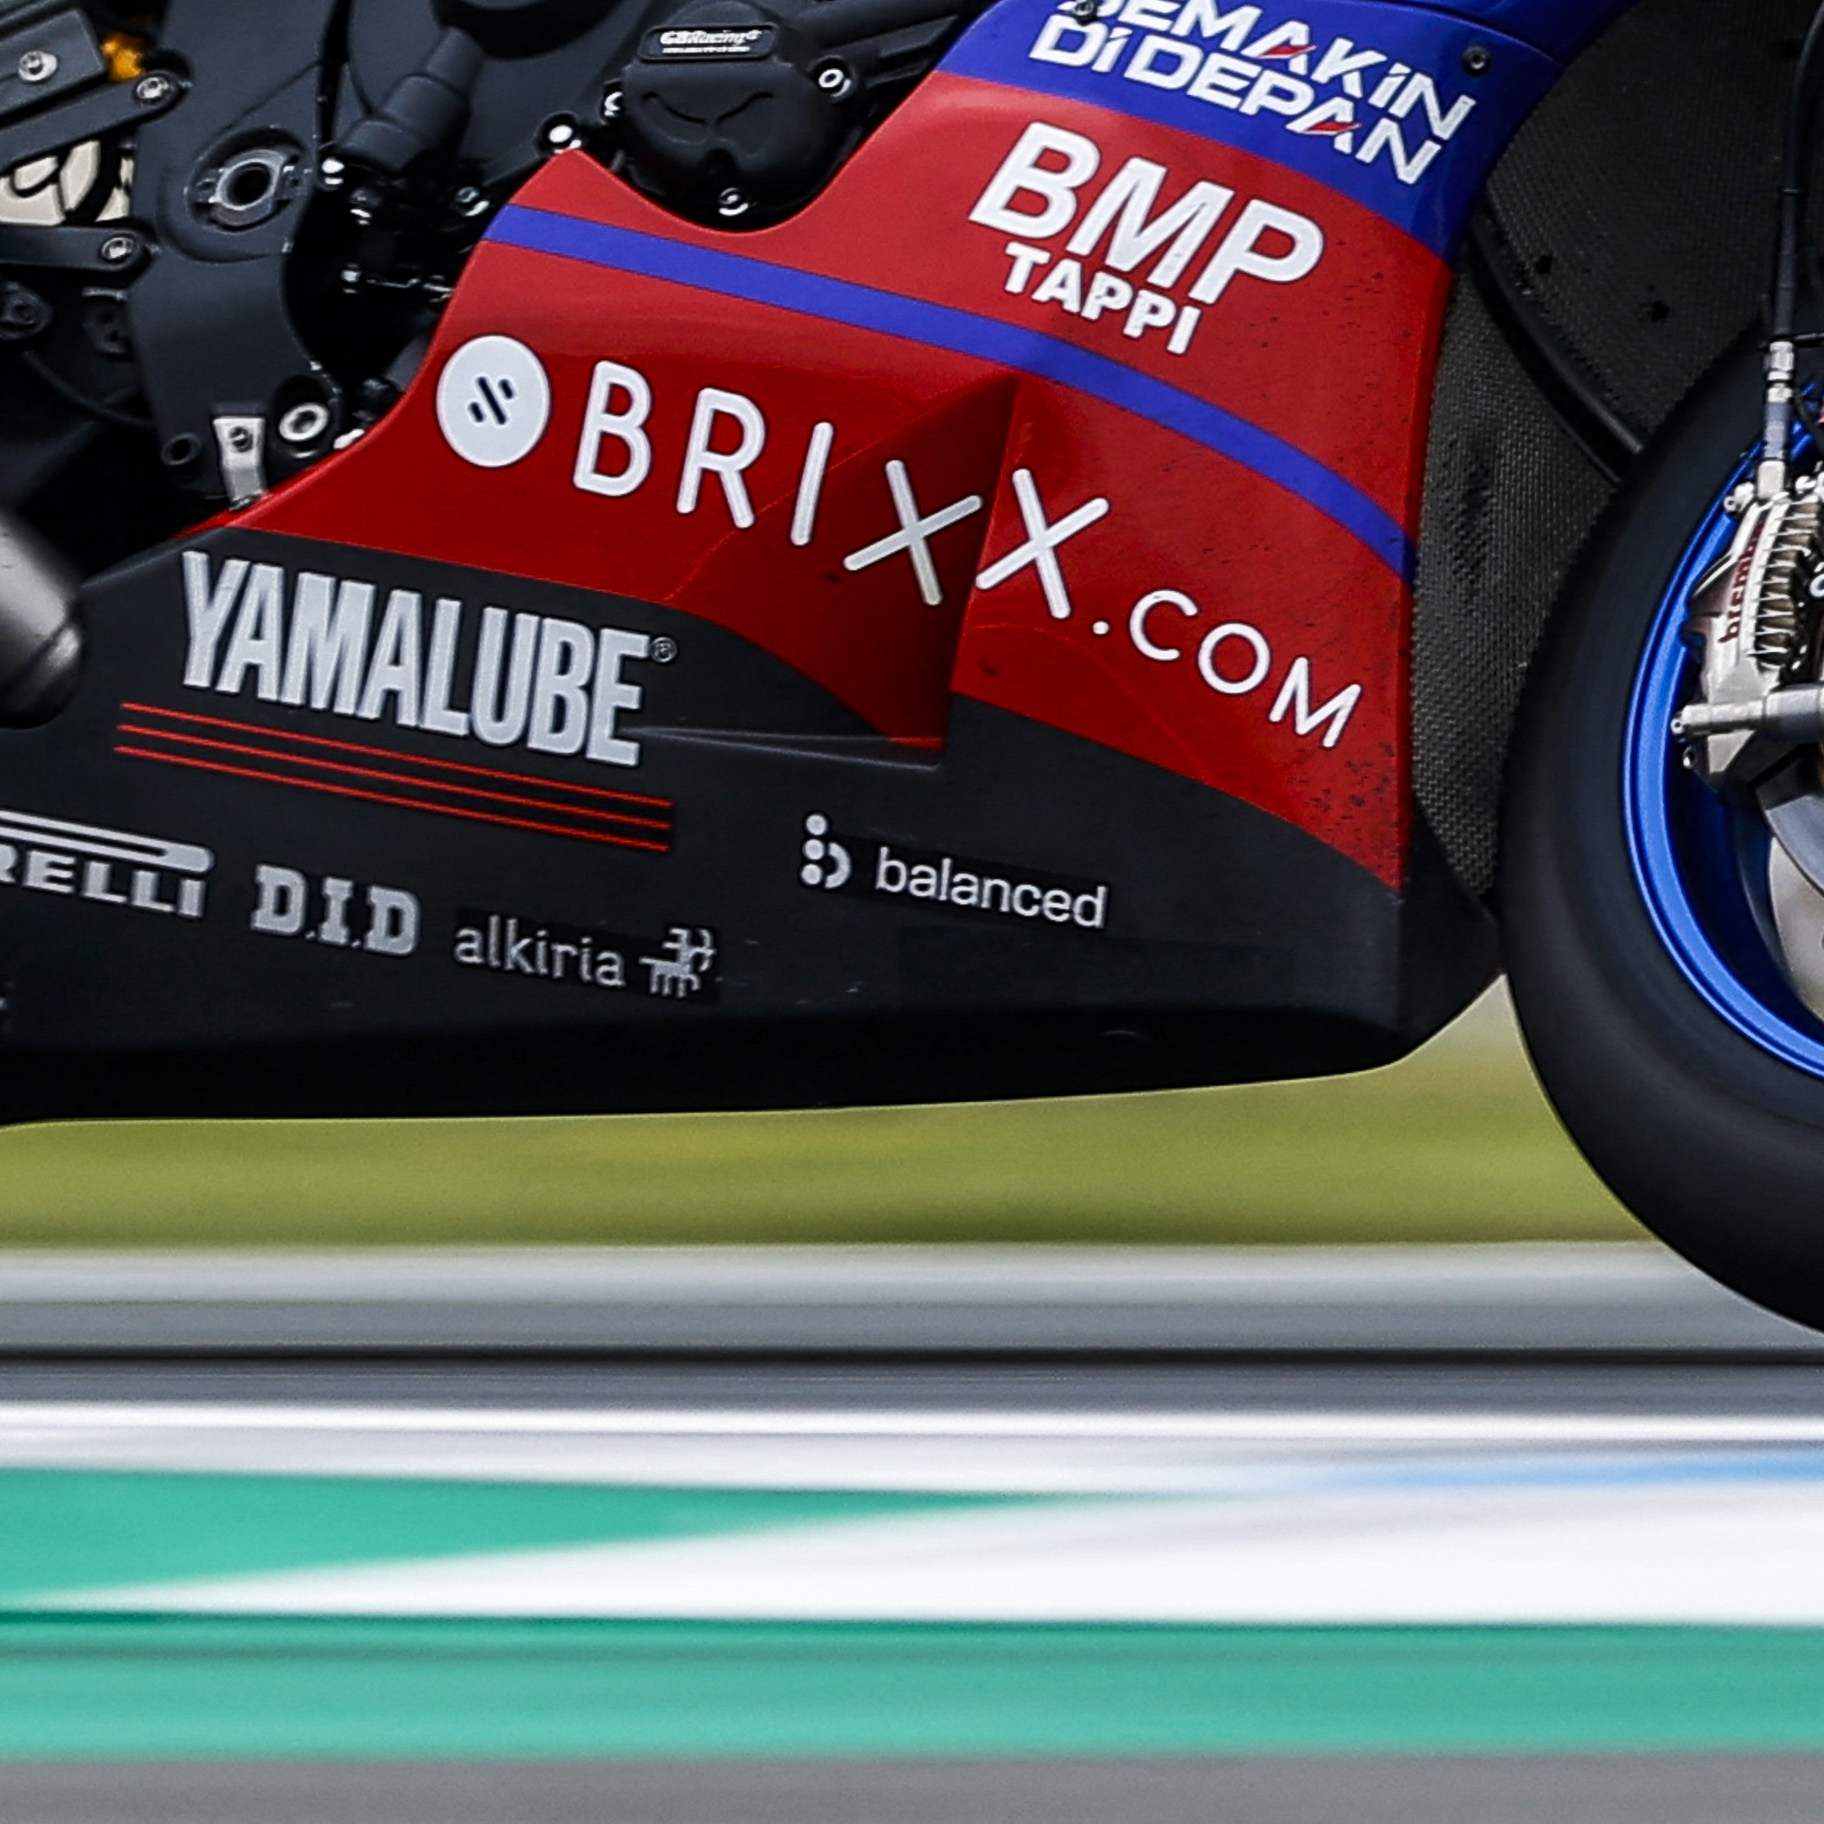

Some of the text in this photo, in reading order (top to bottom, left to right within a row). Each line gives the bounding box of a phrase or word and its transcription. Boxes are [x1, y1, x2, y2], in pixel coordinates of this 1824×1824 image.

[1123, 34, 1441, 185] DEPAN
[968, 122, 1324, 304] BMP
[1003, 240, 1202, 355] TAPPI
[574, 360, 1362, 749] BRIXX.COM
[181, 549, 652, 768] YAMALUBE
[250, 863, 422, 957] D.I.D
[453, 914, 627, 988] alkiria
[875, 846, 1107, 929] balanced
